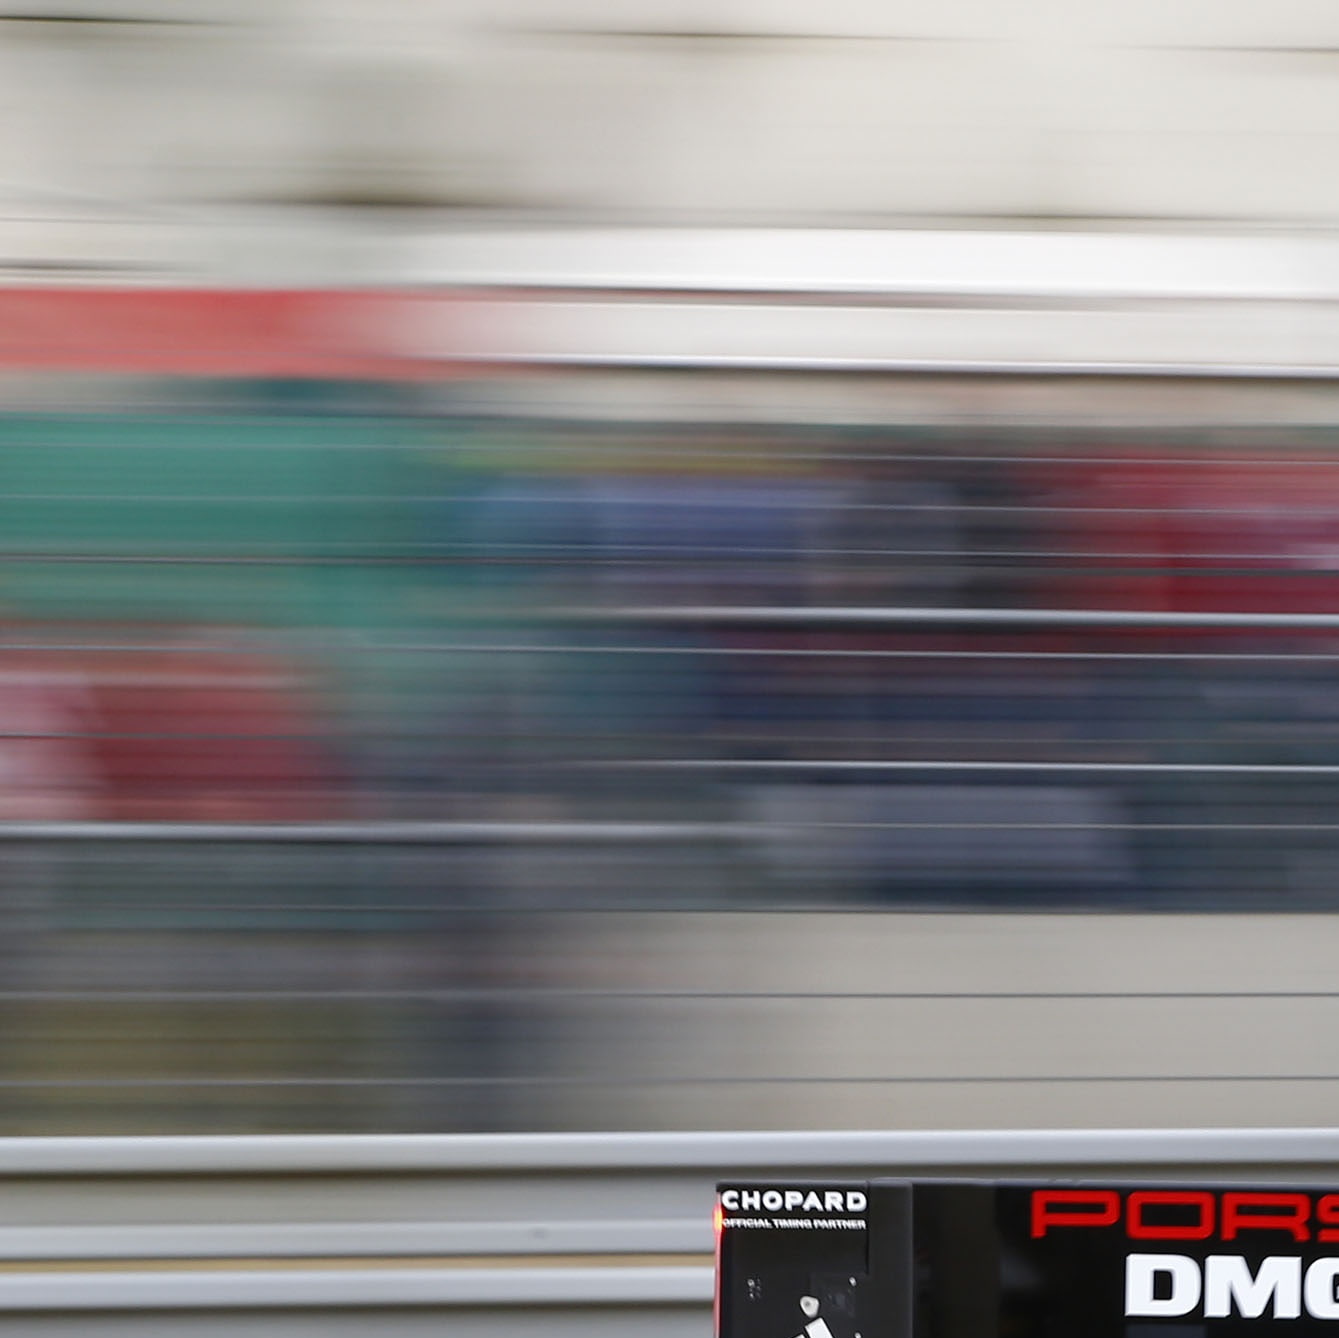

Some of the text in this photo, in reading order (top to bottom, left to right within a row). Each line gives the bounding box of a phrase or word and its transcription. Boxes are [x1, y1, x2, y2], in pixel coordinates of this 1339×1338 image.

[721, 1189, 867, 1212] CHOPARD
[722, 1218, 866, 1231] OFFICIAL TIMING PARTNER
